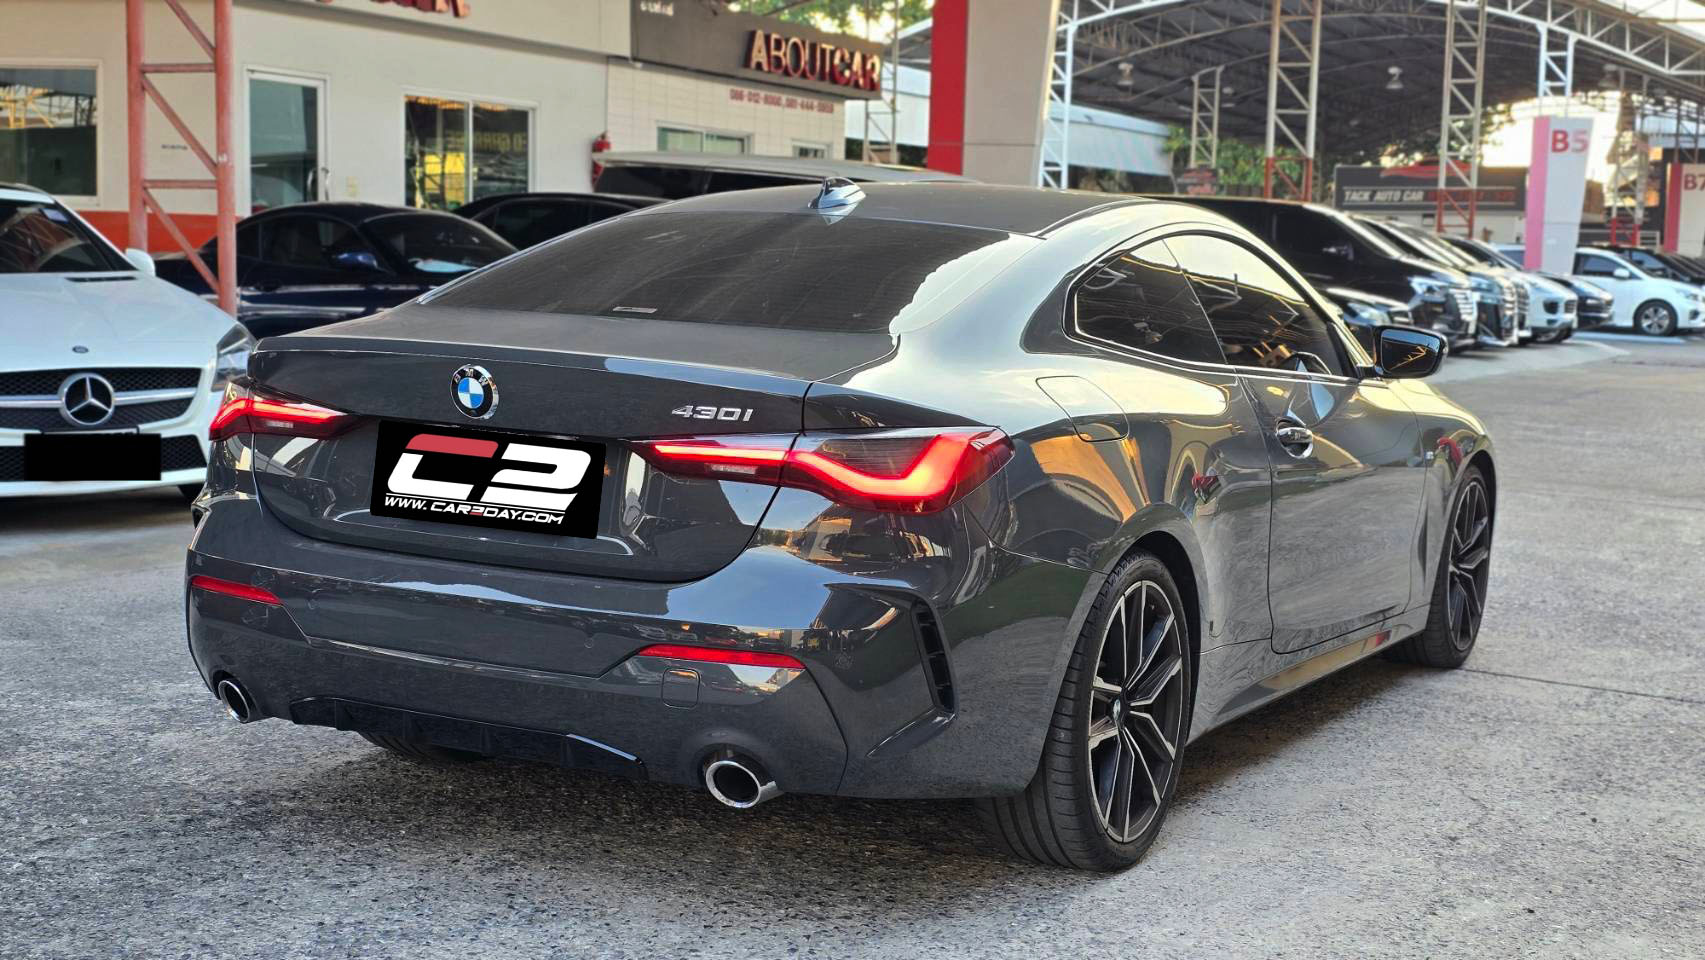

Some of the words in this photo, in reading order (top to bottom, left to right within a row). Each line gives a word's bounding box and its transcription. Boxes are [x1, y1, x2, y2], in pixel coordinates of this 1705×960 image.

[748, 29, 881, 91] ABOUTCAR
[1551, 129, 1588, 153] B5
[1683, 173, 1705, 191] B7
[1373, 190, 1401, 202] AUTO
[1402, 190, 1424, 202] CAR
